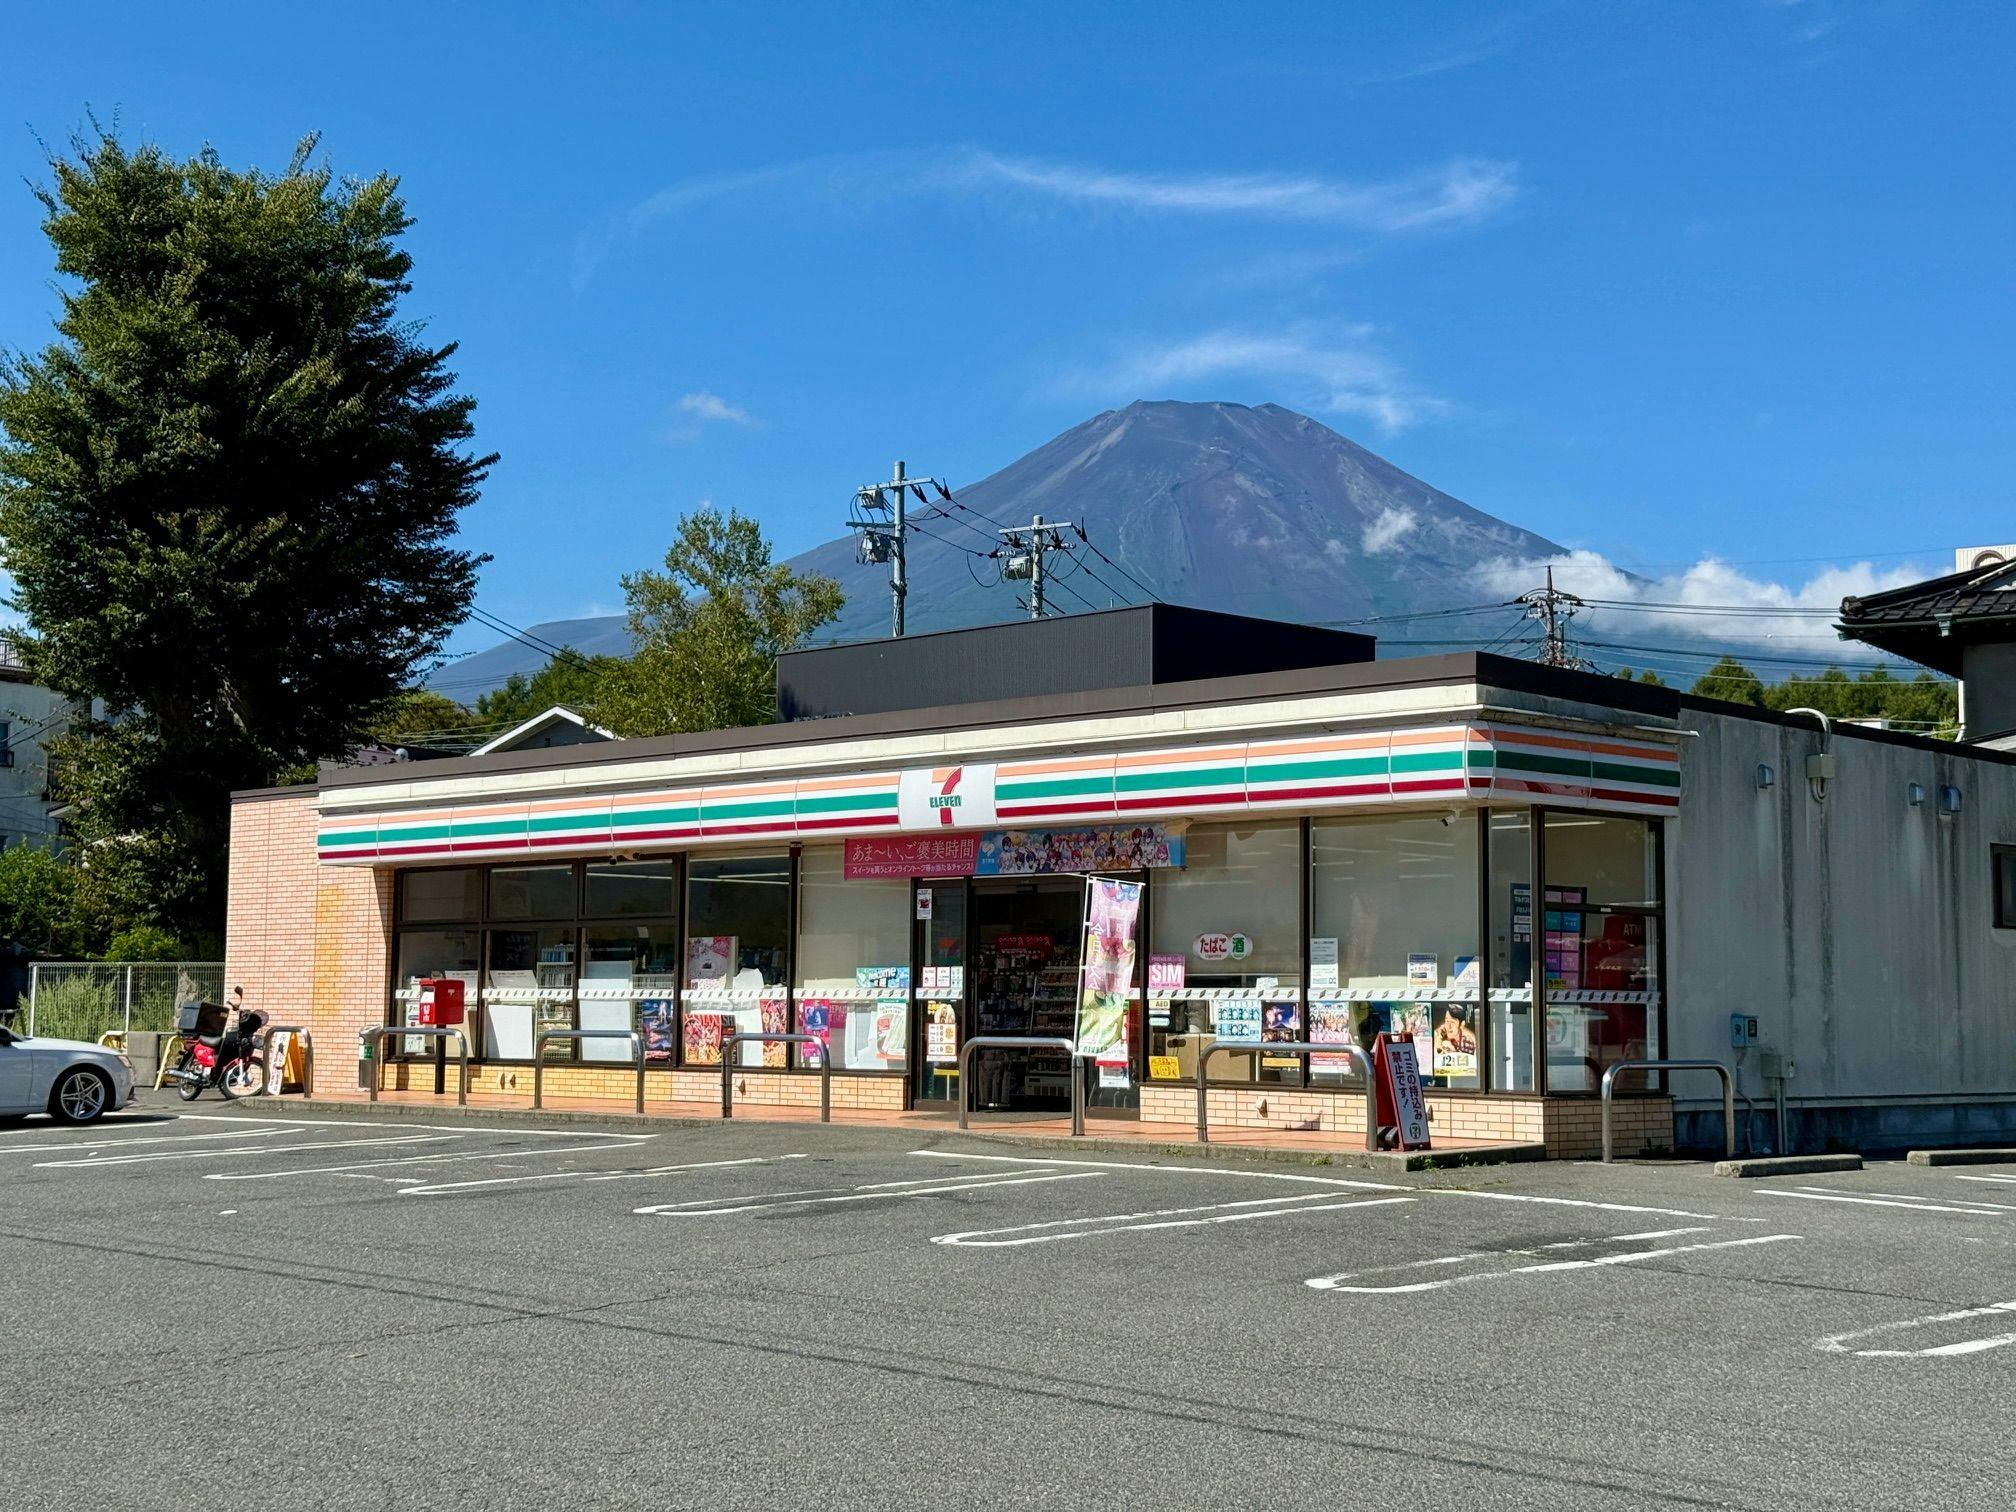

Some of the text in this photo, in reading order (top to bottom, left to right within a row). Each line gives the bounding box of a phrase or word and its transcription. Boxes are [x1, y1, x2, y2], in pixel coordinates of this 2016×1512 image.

[1623, 923, 1642, 936] ATM
[1200, 937, 1228, 954] たばこ
[1232, 937, 1245, 953] 酒
[1151, 963, 1182, 983] SIM
[1403, 1050, 1422, 1120] ゴミの持込み
